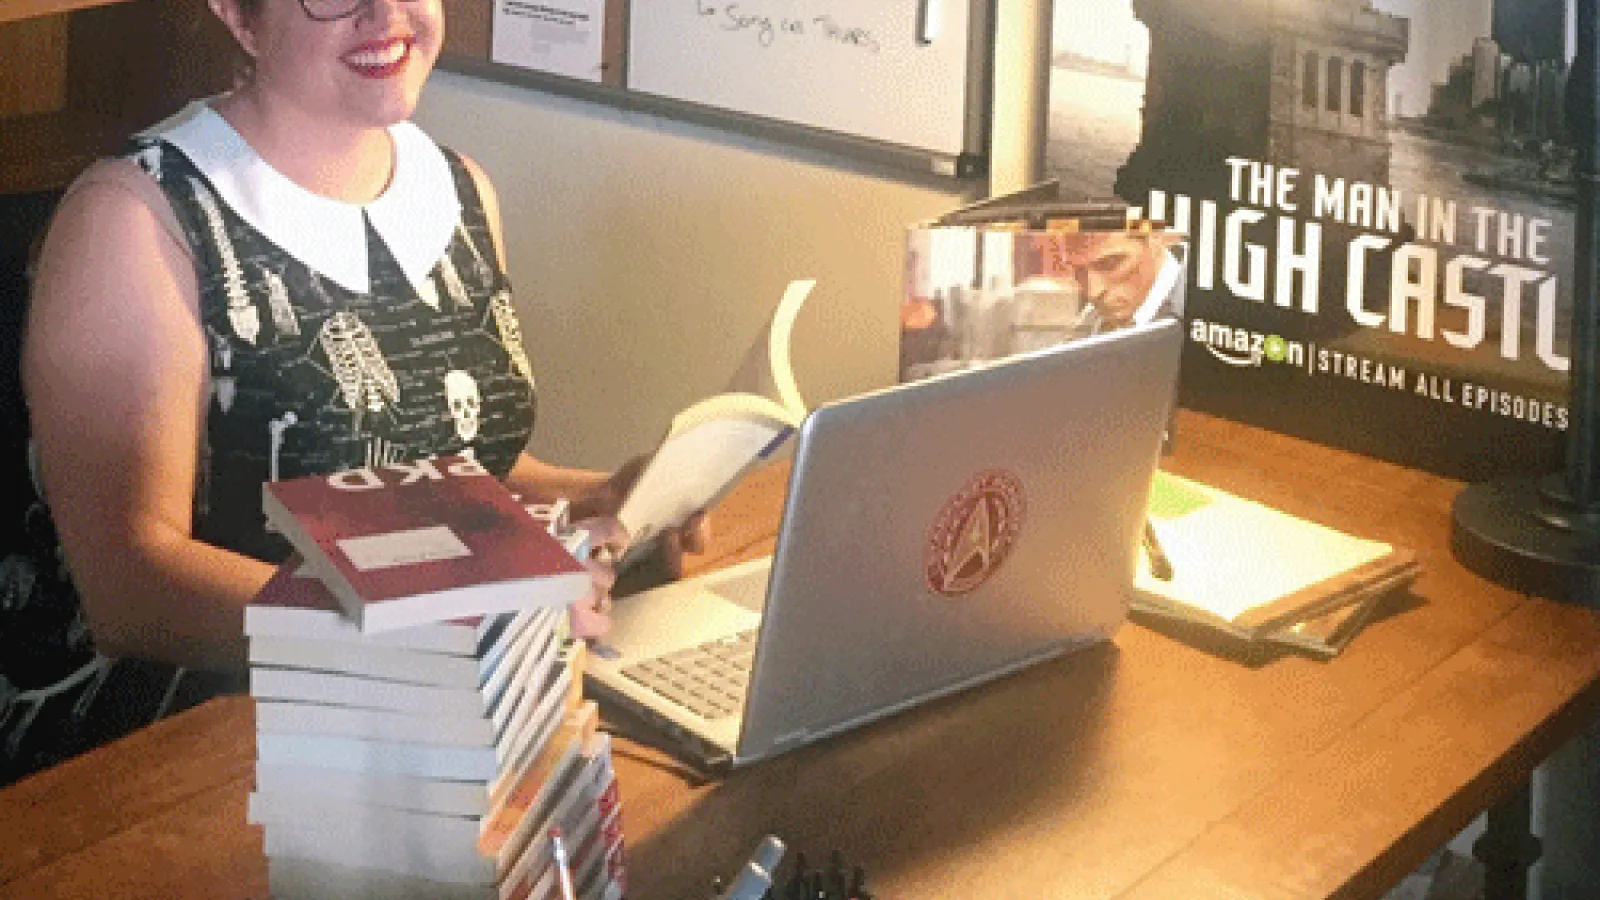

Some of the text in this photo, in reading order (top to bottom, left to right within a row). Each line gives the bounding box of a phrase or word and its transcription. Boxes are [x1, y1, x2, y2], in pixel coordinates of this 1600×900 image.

[1225, 156, 1553, 264] THE MAN IN THE
[1189, 318, 1303, 367] amazon
[1346, 233, 1571, 371] CASTL
[1317, 349, 1569, 431] STREAM ALL EPISODES
